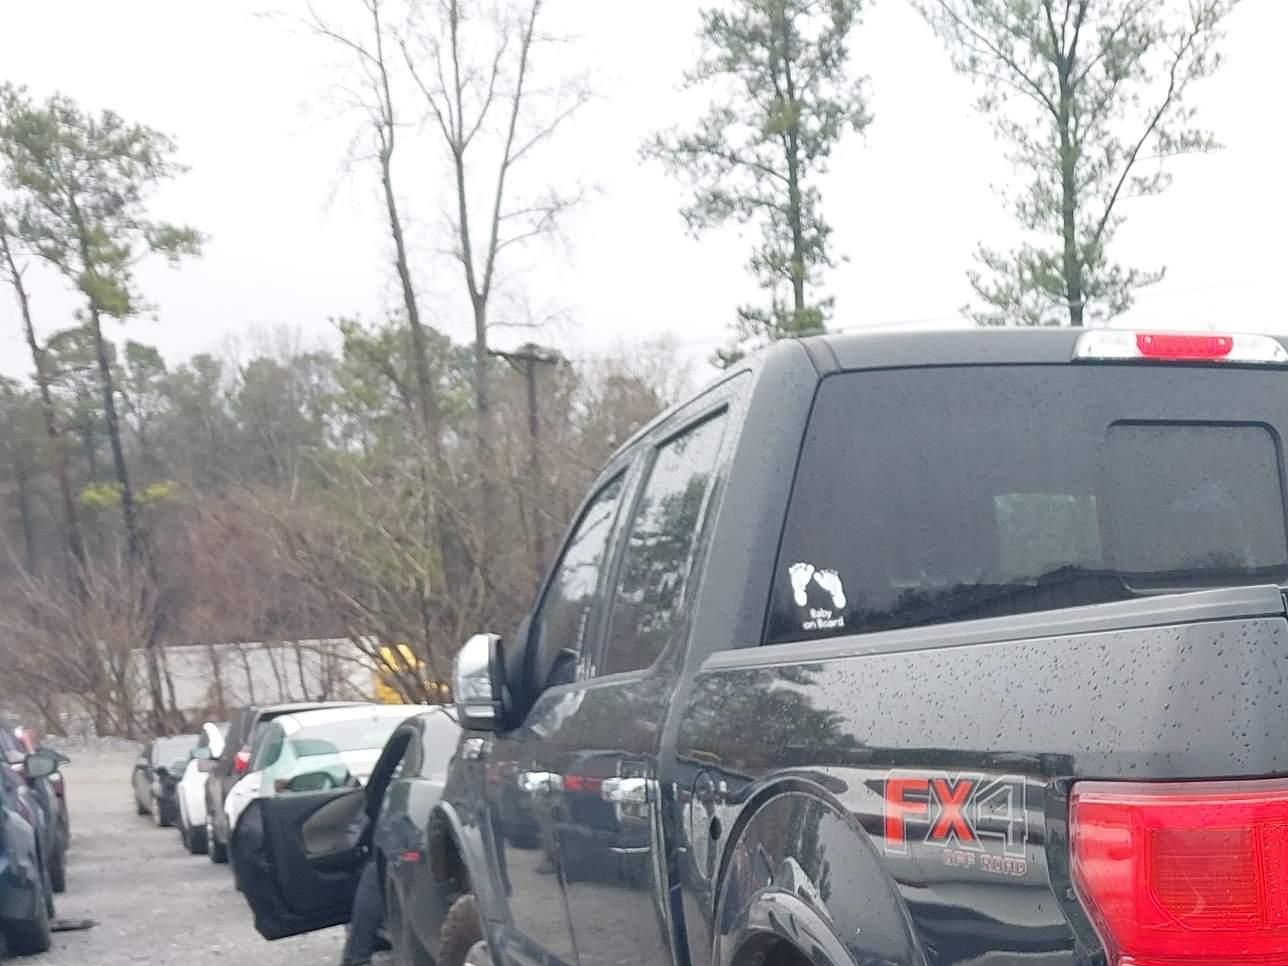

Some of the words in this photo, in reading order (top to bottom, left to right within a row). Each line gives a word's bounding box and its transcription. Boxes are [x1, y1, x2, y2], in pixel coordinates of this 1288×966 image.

[884, 768, 1028, 858] FX4
[943, 849, 976, 869] OFF
[980, 854, 1028, 877] ROAD
